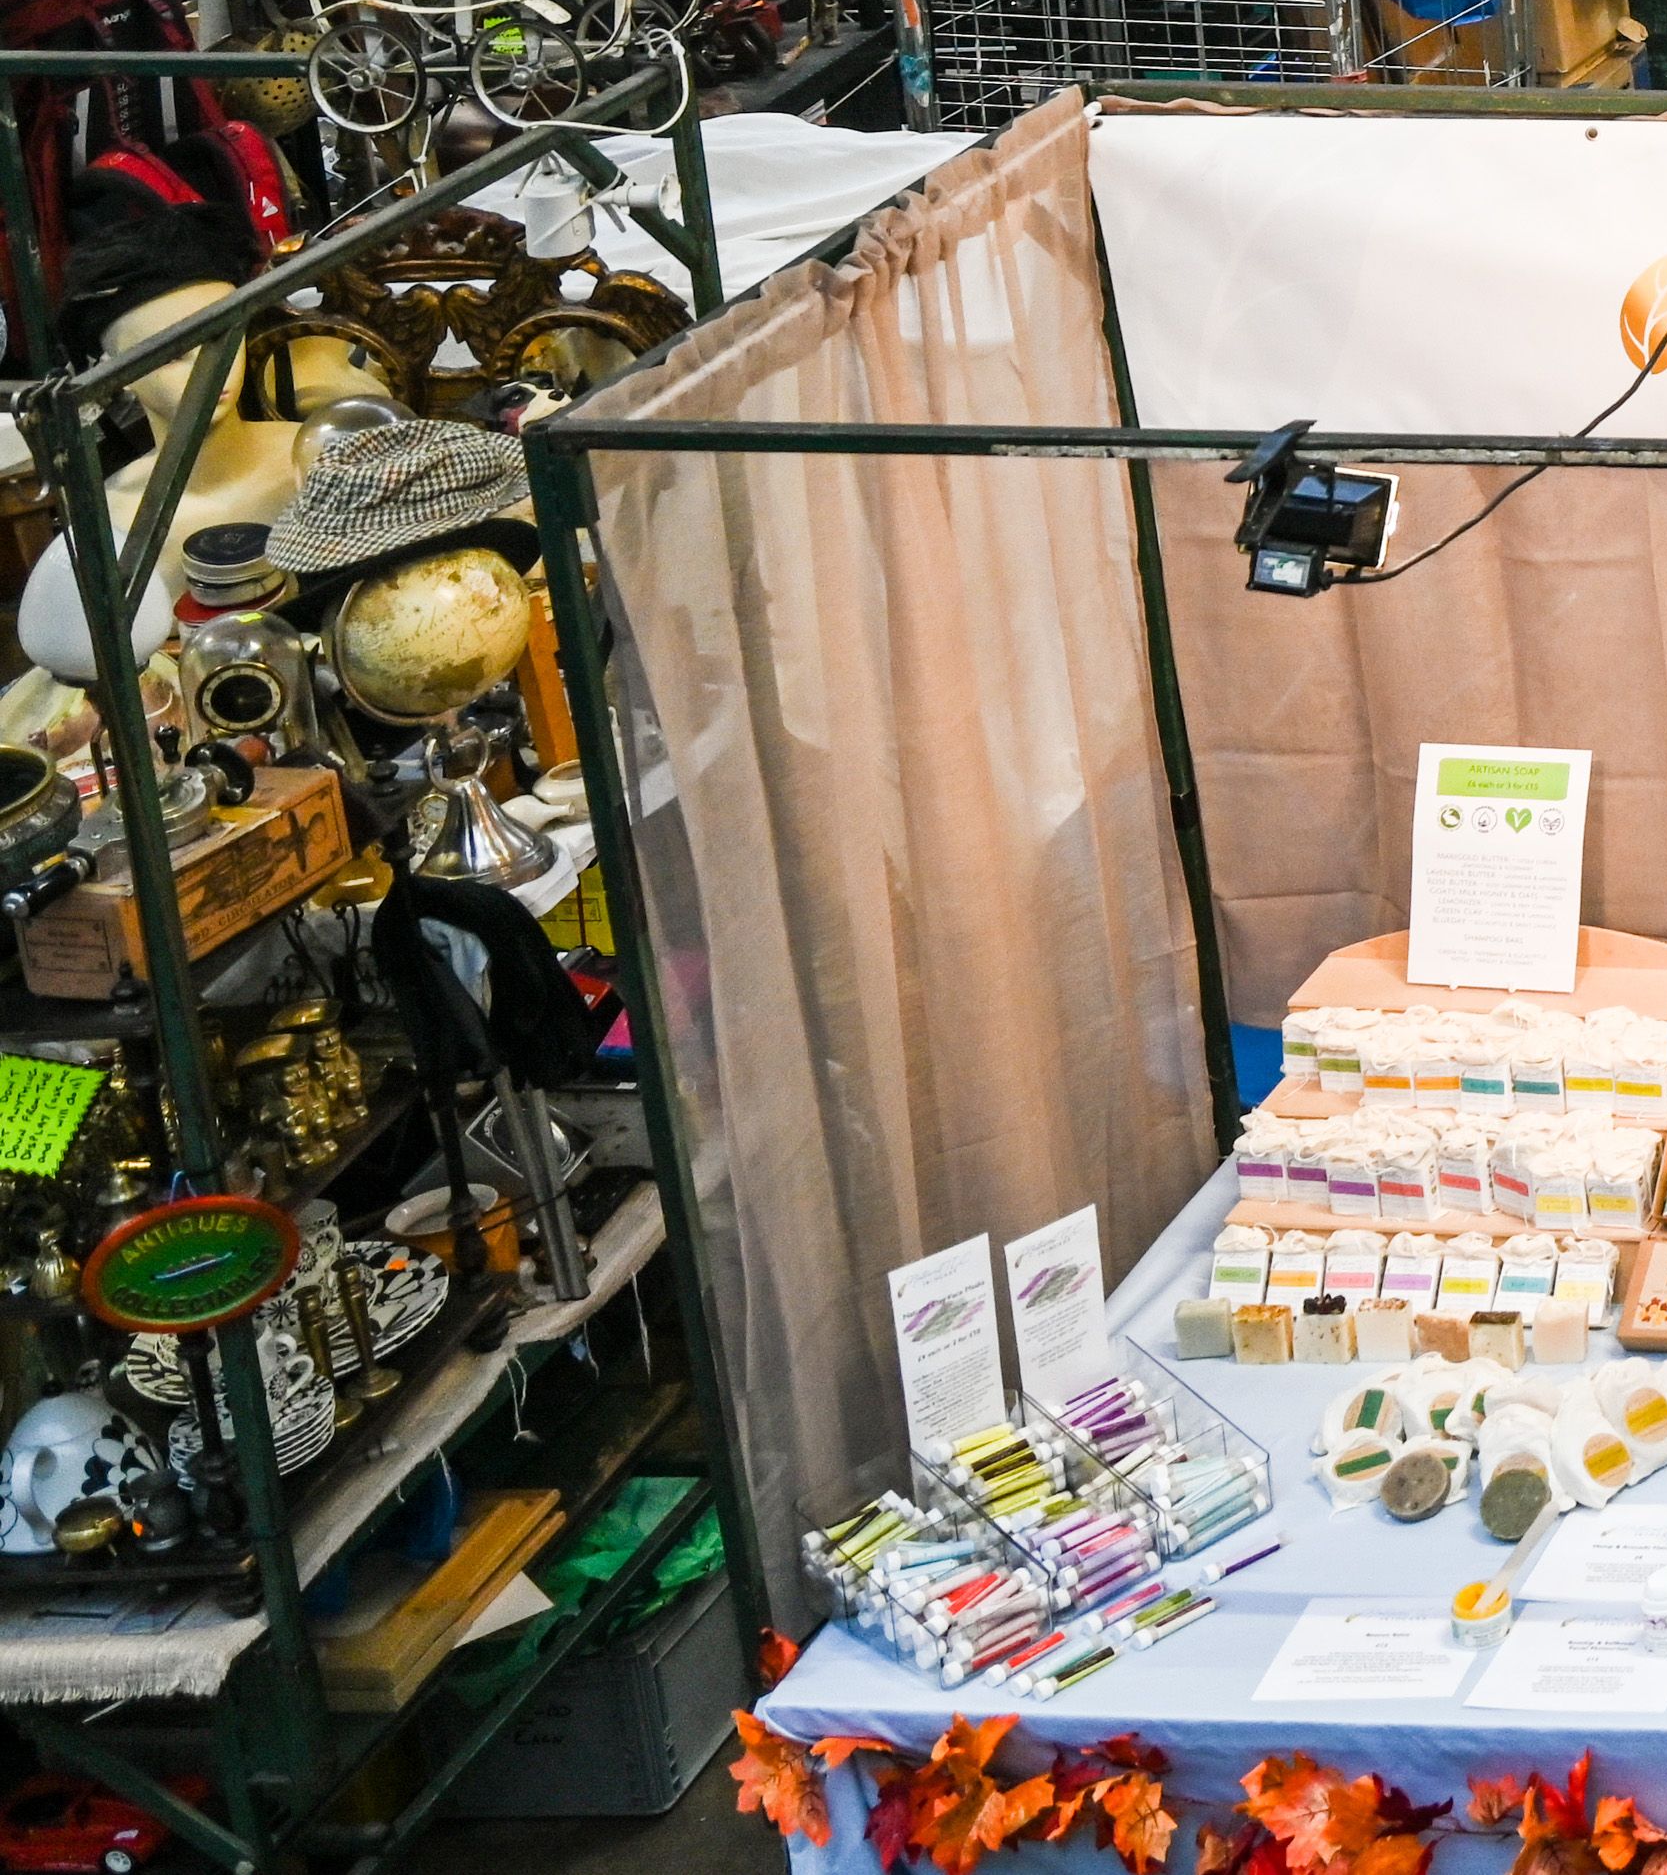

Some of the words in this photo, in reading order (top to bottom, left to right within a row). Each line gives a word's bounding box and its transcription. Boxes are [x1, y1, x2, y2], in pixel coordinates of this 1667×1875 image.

[1469, 765, 1511, 775] ARTISAN
[1514, 766, 1541, 776] SOAP
[120, 1213, 250, 1264] ANTIQUES
